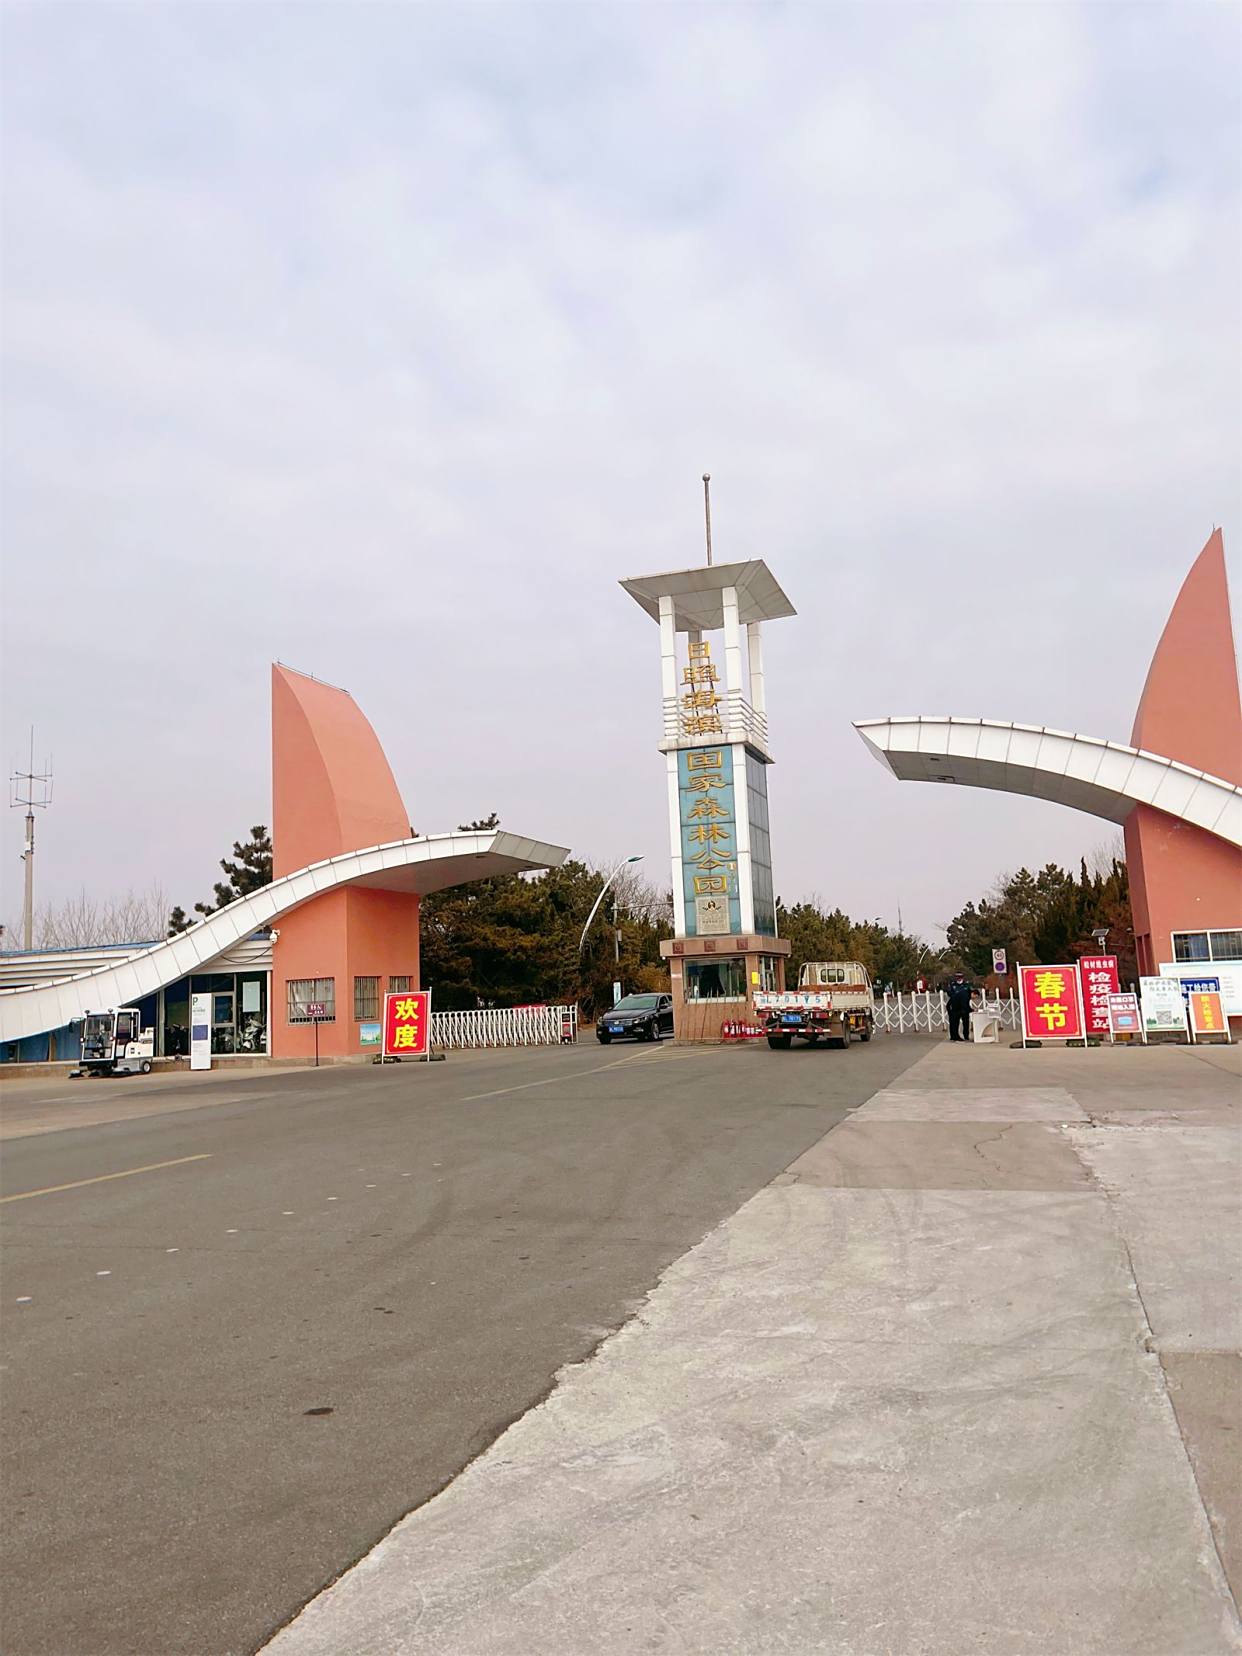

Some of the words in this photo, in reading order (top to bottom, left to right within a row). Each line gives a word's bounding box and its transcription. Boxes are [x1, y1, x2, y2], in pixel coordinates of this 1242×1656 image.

[680, 641, 723, 736] 日照海滨
[685, 751, 733, 895] 国家森林公园
[393, 997, 419, 1049] 欢度
[1033, 971, 1069, 1031] 春节
